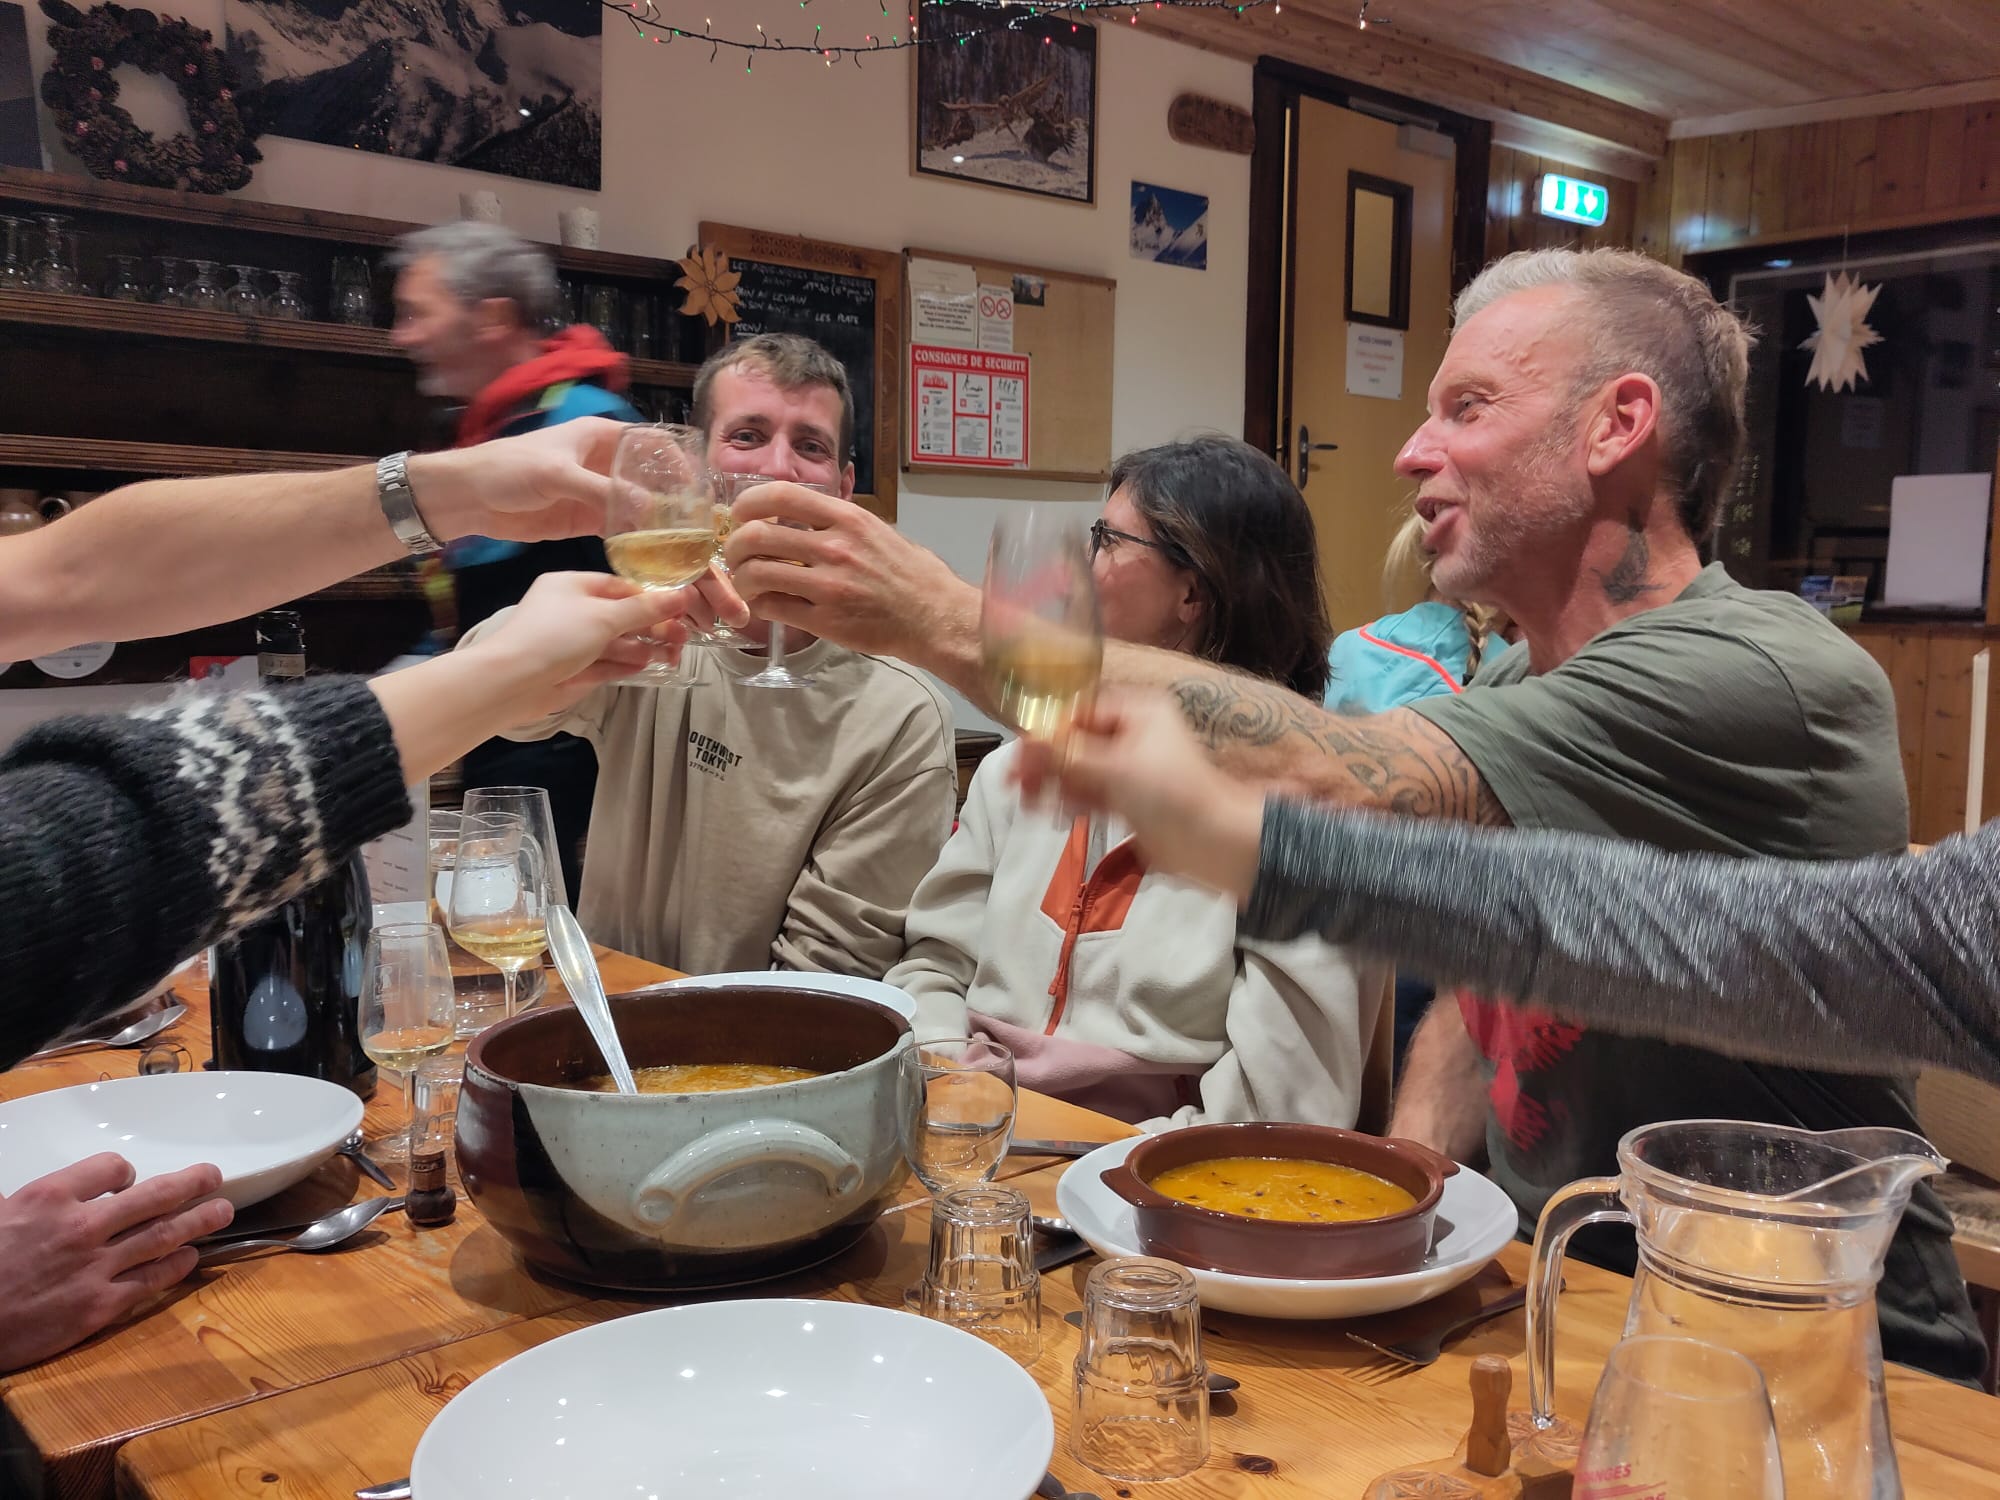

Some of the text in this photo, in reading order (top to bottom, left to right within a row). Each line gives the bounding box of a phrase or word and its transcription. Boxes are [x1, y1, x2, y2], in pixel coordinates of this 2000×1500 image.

[772, 292, 807, 305] LEVAIN
[815, 312, 832, 322] LES
[735, 321, 763, 333] MENU
[914, 349, 968, 366] CONSIGNES
[970, 355, 983, 369] DE
[695, 747, 727, 772] TOKYO
